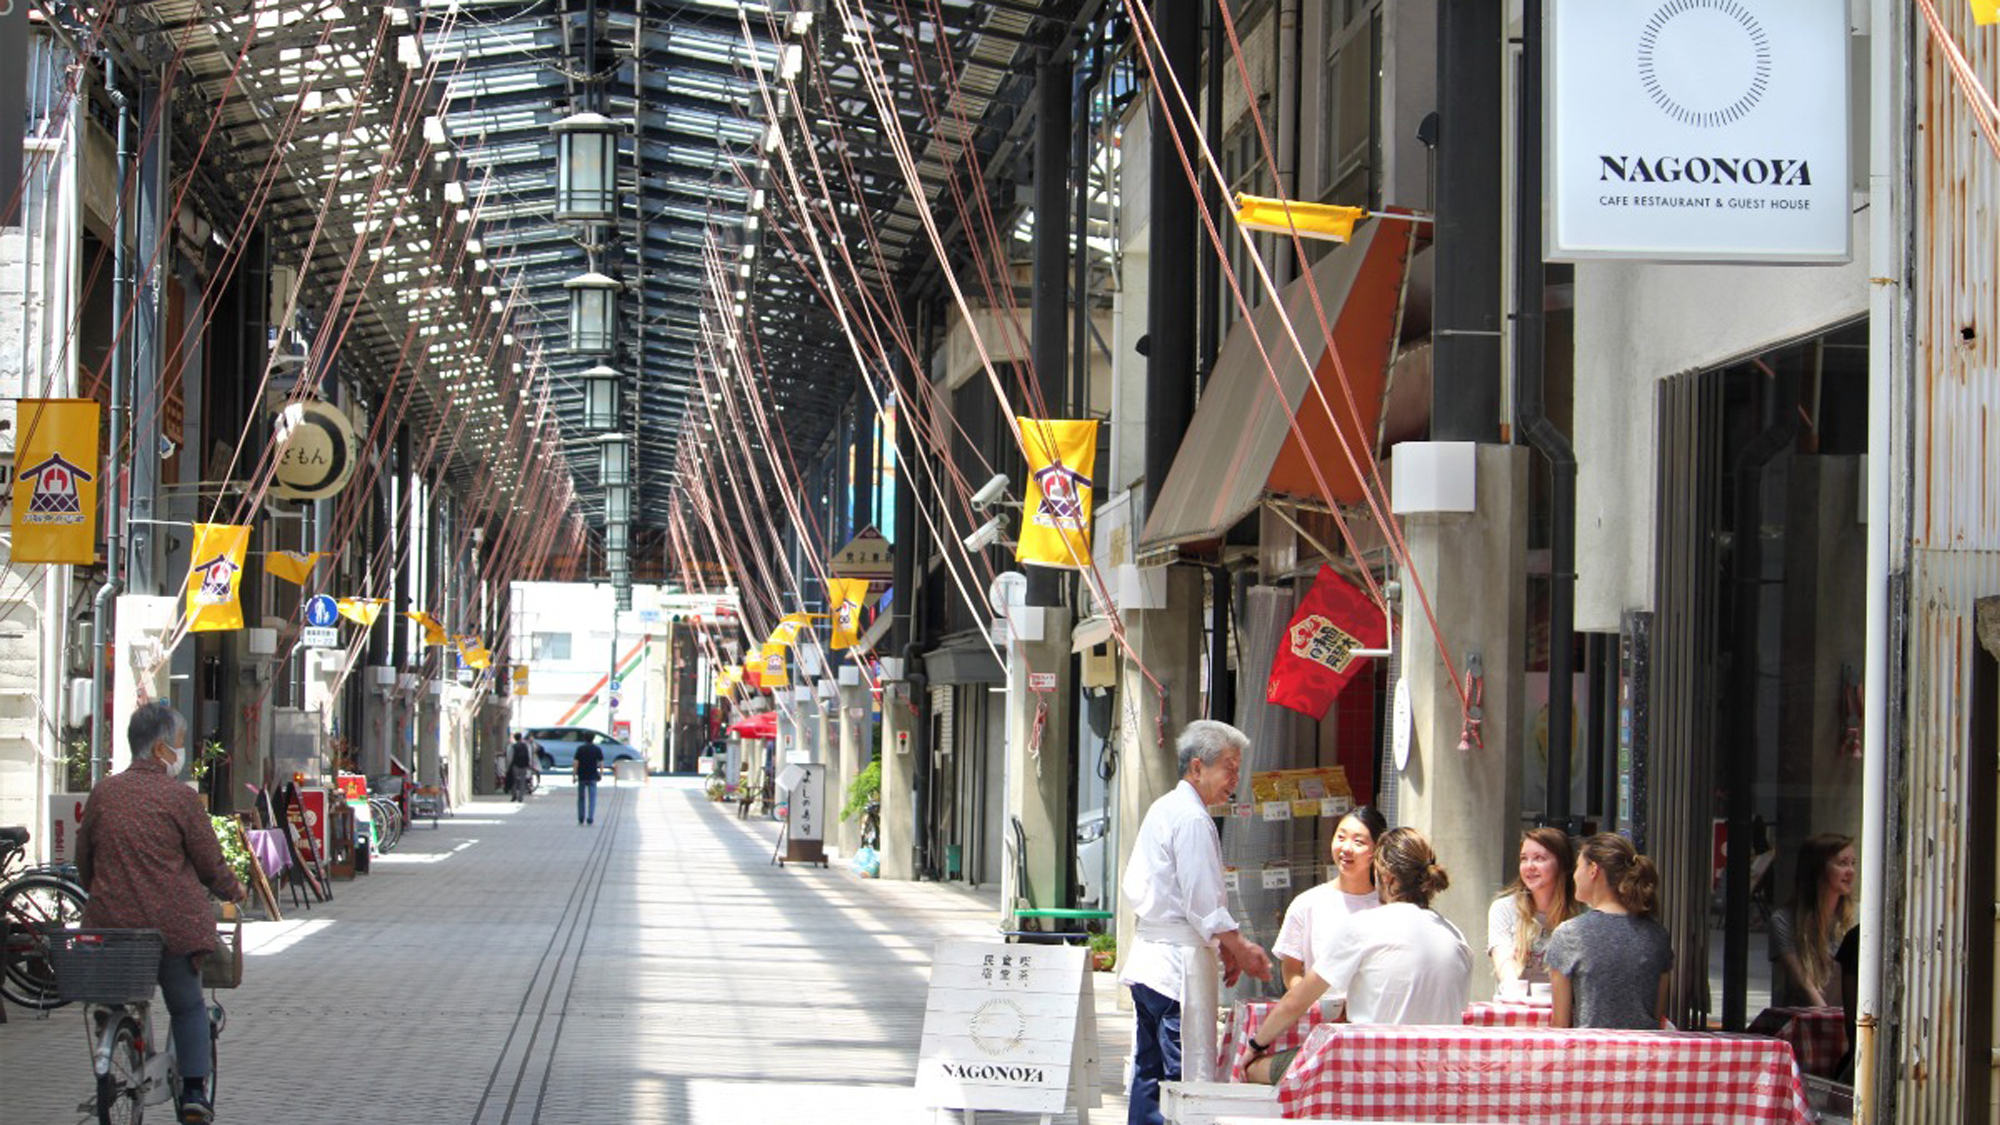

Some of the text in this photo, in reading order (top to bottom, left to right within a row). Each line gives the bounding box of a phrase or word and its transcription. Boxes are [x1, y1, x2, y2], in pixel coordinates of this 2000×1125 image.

[1599, 155, 1812, 186] NAGONOYA
[1599, 196, 1810, 210] CAFE RESTAURANT & GUEST HOUSE
[942, 1063, 1043, 1083] NAGONOYA
